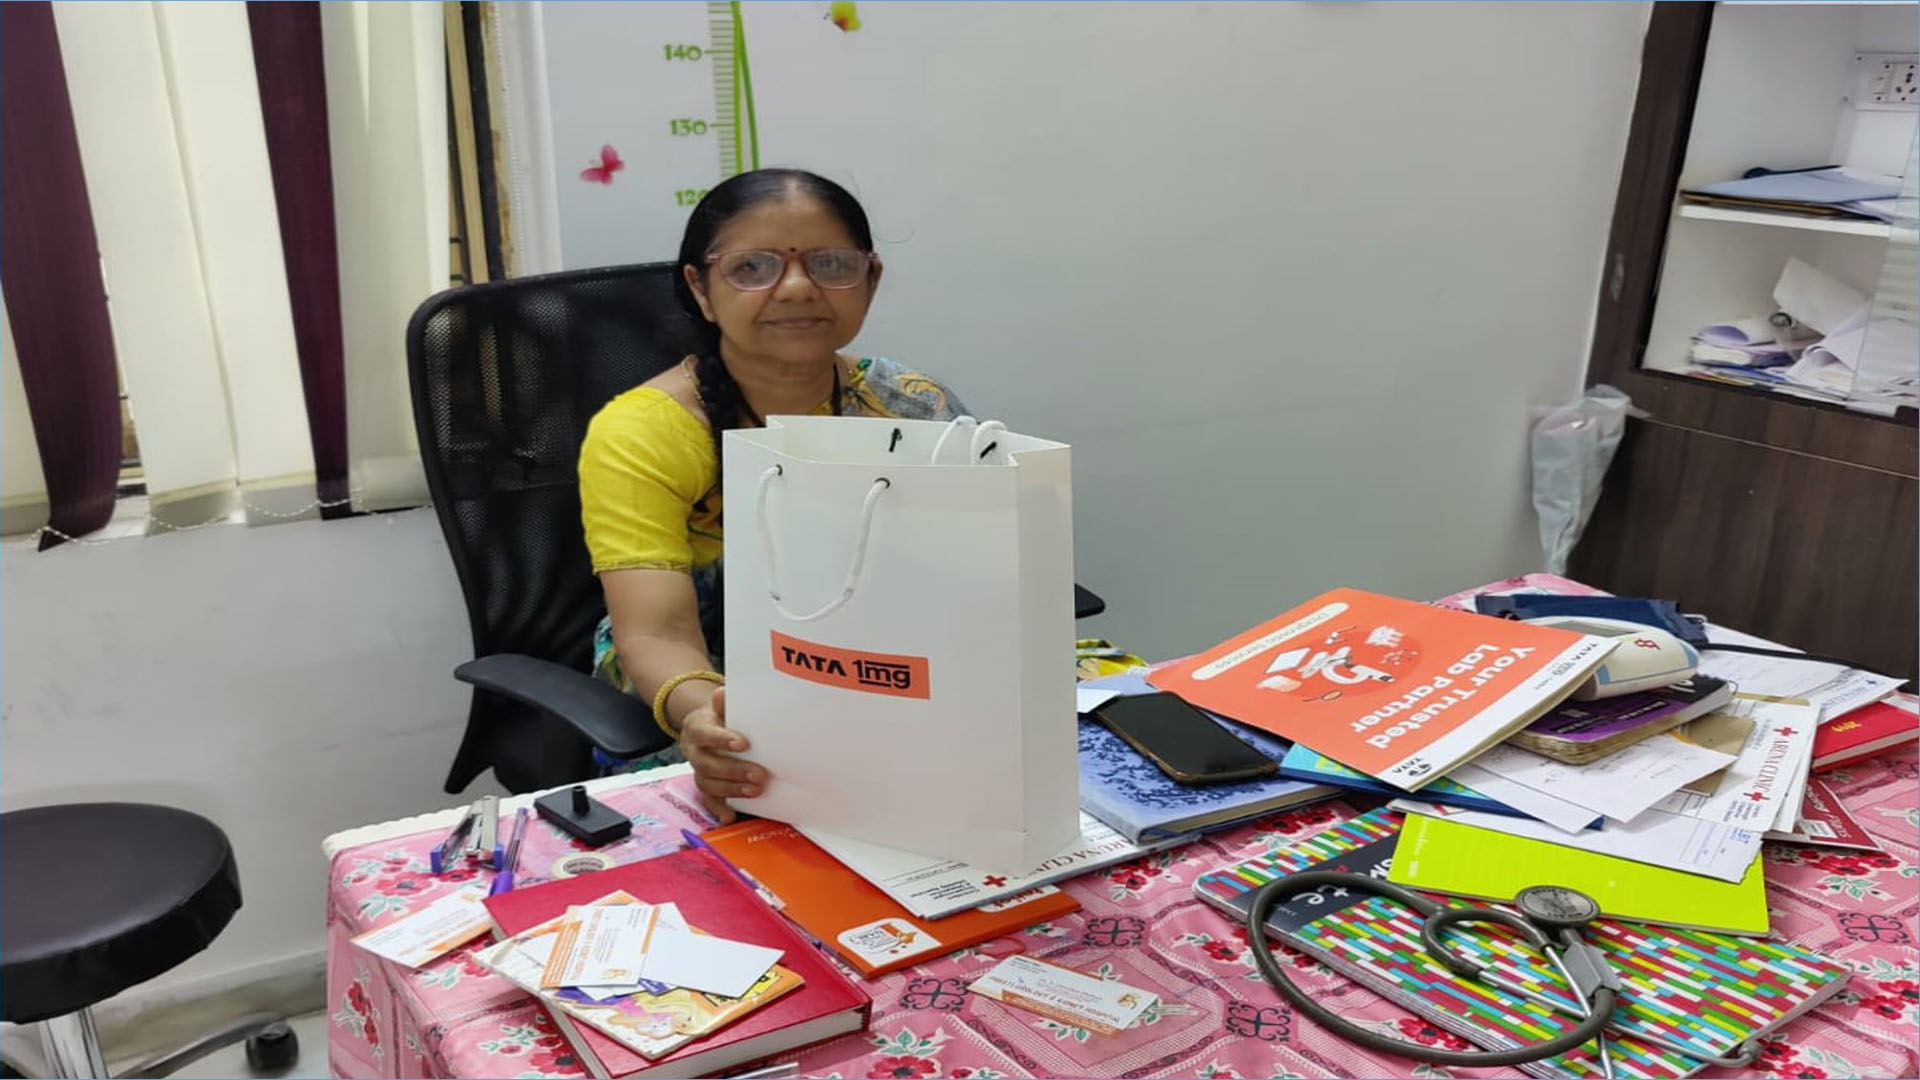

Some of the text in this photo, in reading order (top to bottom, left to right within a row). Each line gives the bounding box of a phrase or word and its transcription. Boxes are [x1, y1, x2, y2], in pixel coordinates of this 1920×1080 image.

[663, 43, 702, 61] 140
[669, 118, 707, 136] 130
[1571, 642, 1599, 661] TATA
[781, 645, 911, 690] TATA 1mg
[1350, 643, 1500, 733] Lab Partner
[1365, 646, 1536, 749] Your Trusted
[1391, 757, 1423, 774] TATA
